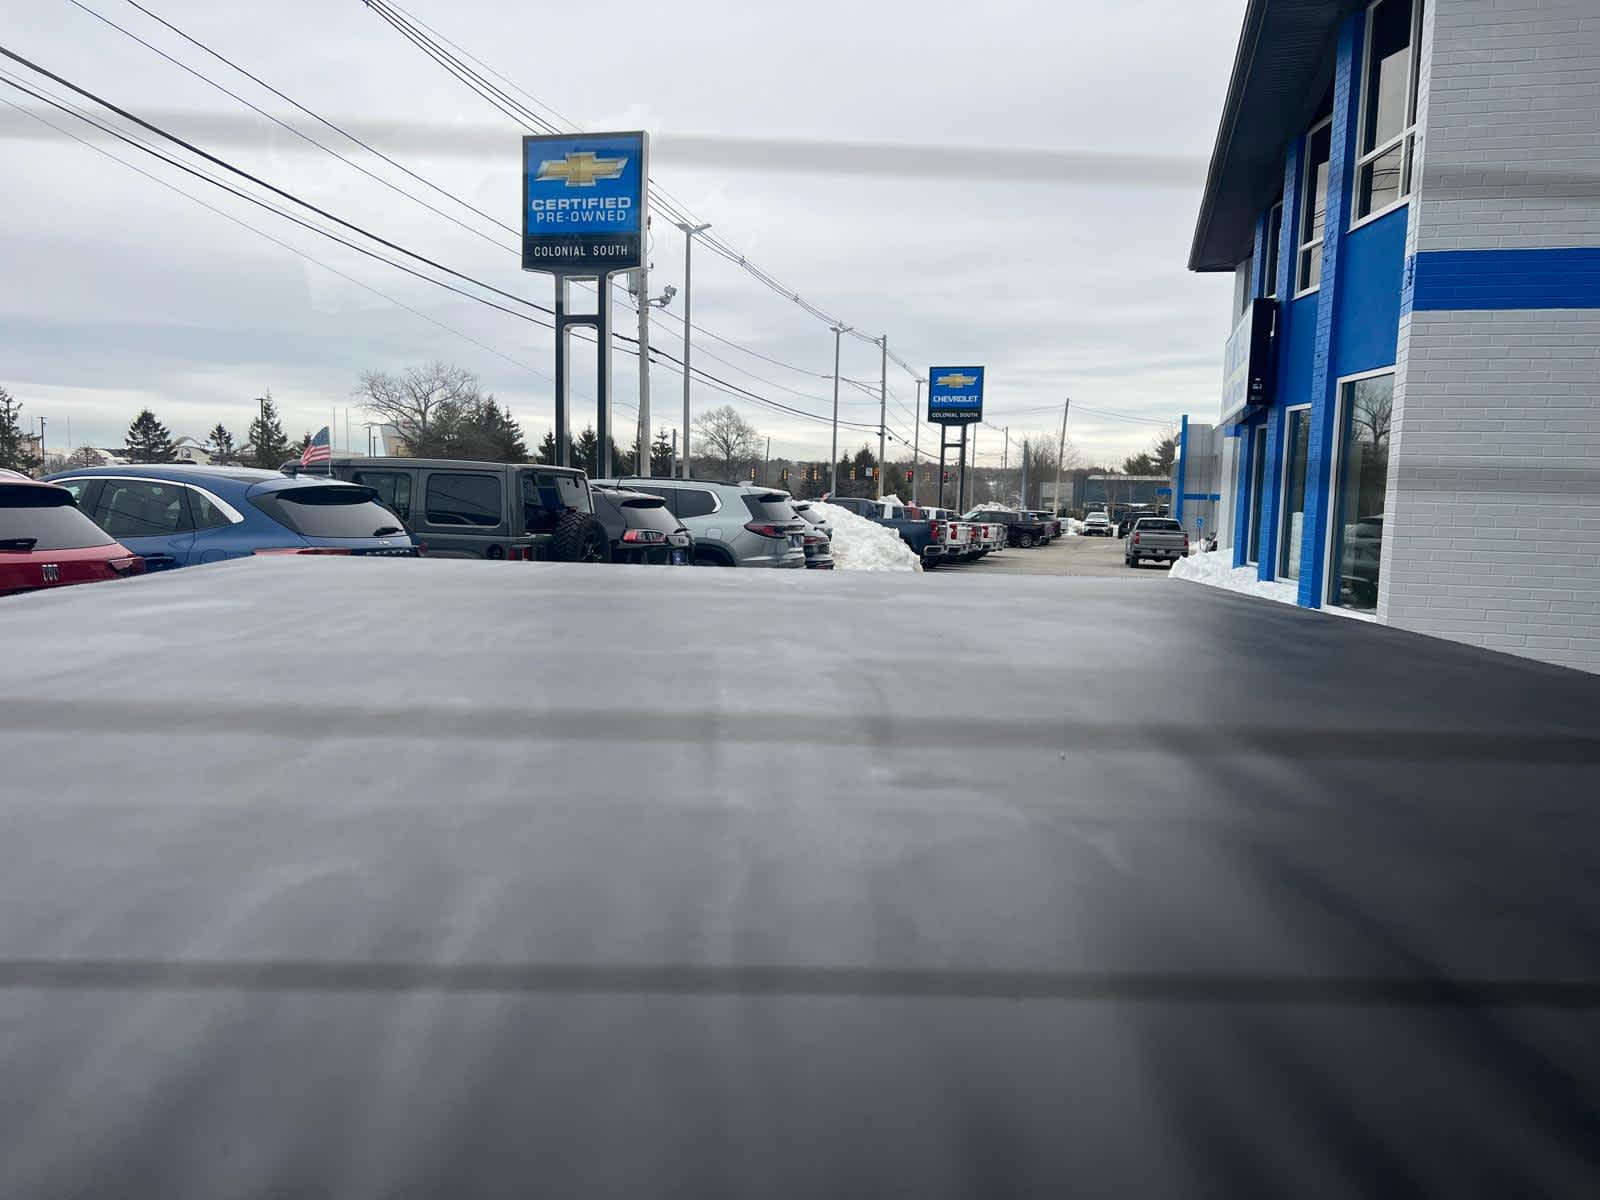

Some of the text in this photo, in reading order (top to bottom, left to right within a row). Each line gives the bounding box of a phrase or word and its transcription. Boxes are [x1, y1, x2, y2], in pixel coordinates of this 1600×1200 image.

[531, 197, 632, 211] CERTIFIED
[536, 210, 626, 223] PRE-OWNED
[534, 245, 628, 257] COLONIAL SOUTH
[933, 395, 978, 403] CHEVROLET
